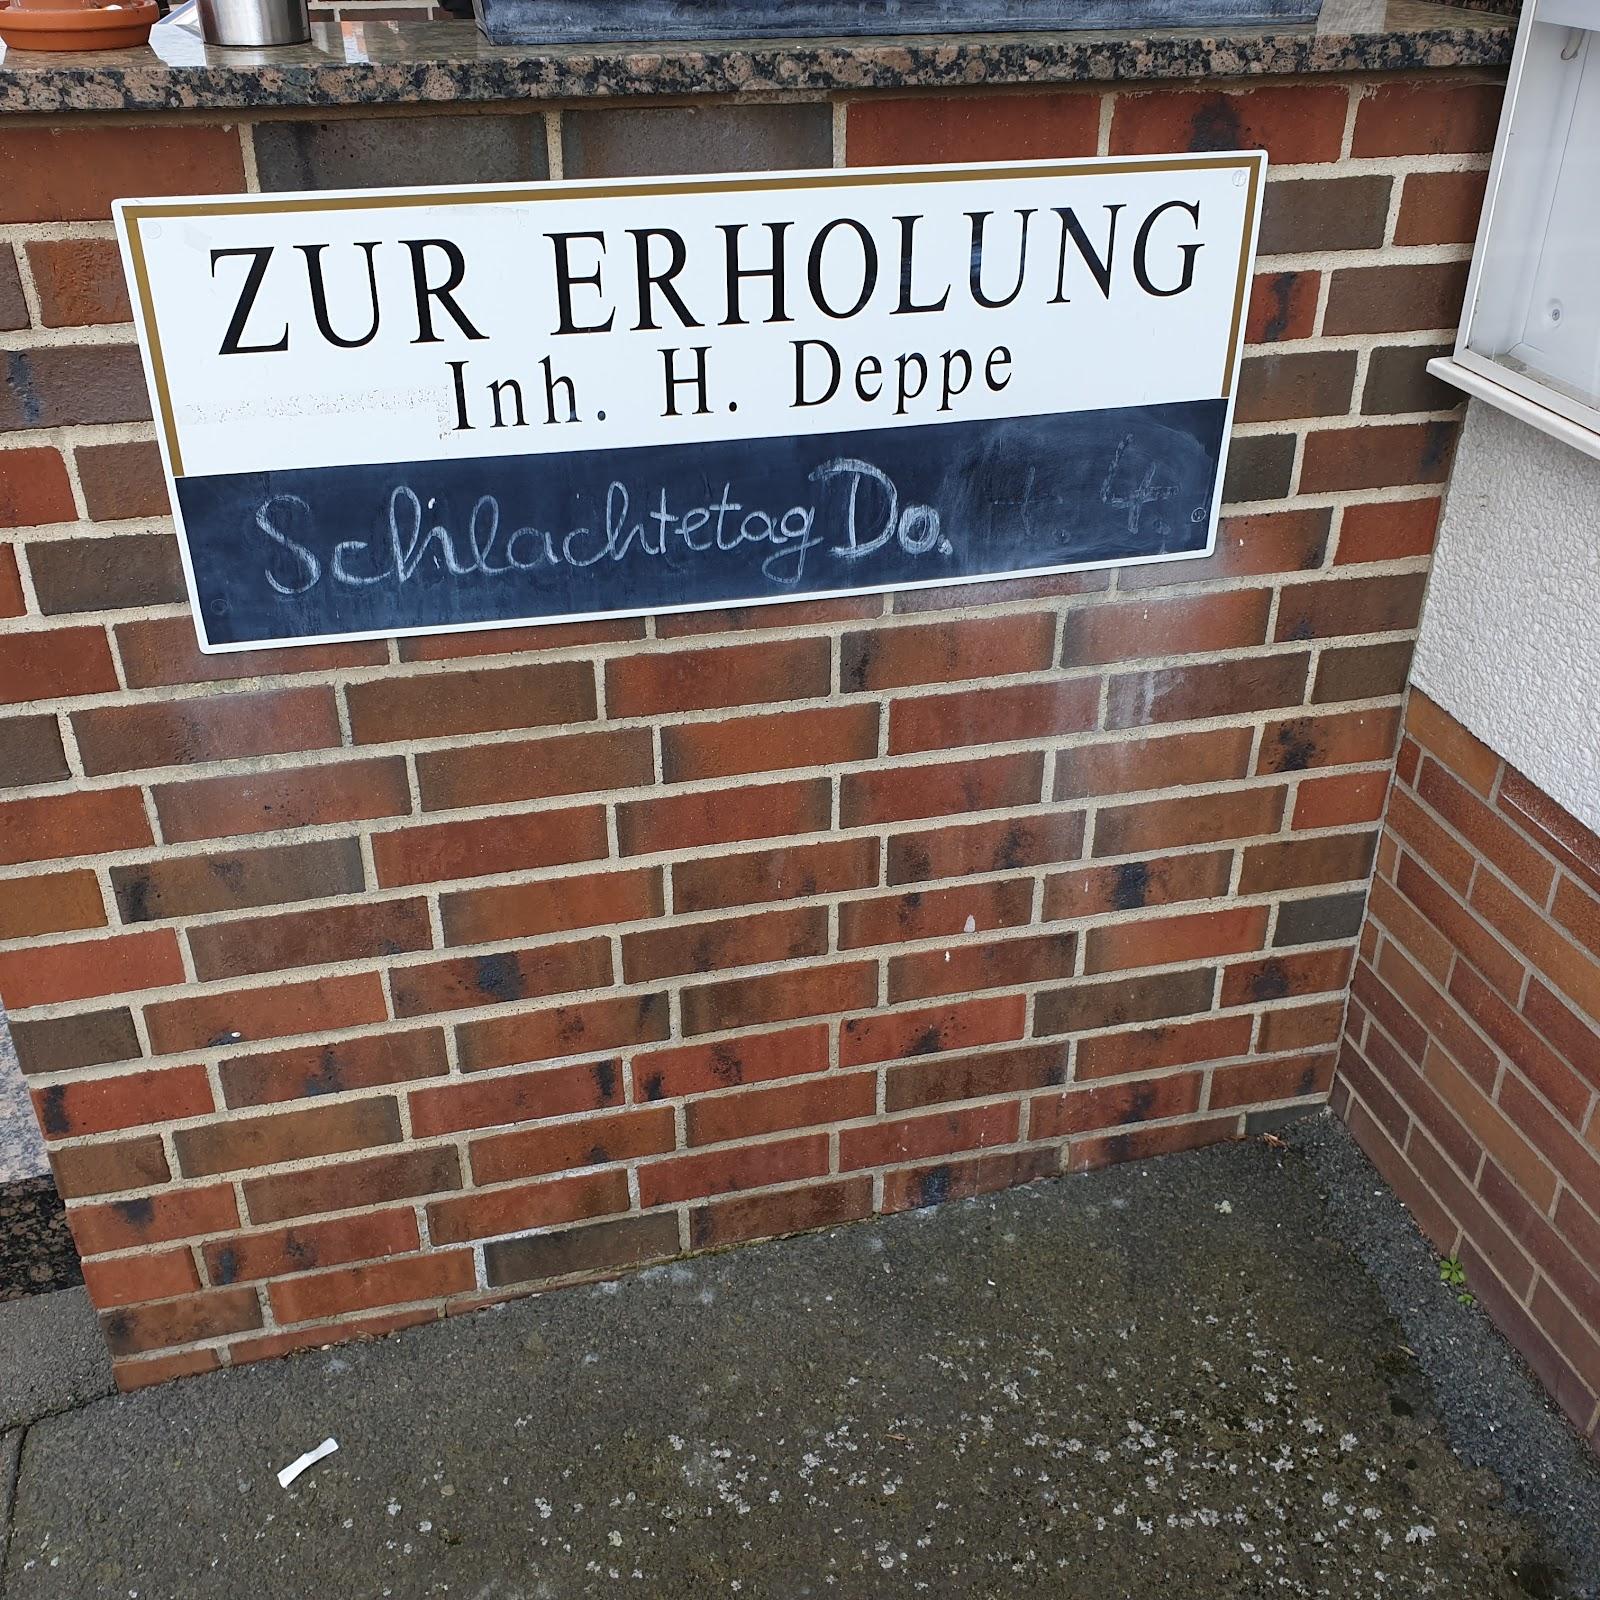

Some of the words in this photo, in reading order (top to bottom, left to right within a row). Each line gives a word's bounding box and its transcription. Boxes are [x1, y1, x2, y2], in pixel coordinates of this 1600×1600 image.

[210, 239, 490, 355] ZUR
[543, 200, 1205, 336] ERHOLUNG
[446, 355, 607, 430] Inh.
[658, 345, 738, 416] H.
[788, 339, 1013, 415] Deppe
[808, 457, 954, 560] Do.
